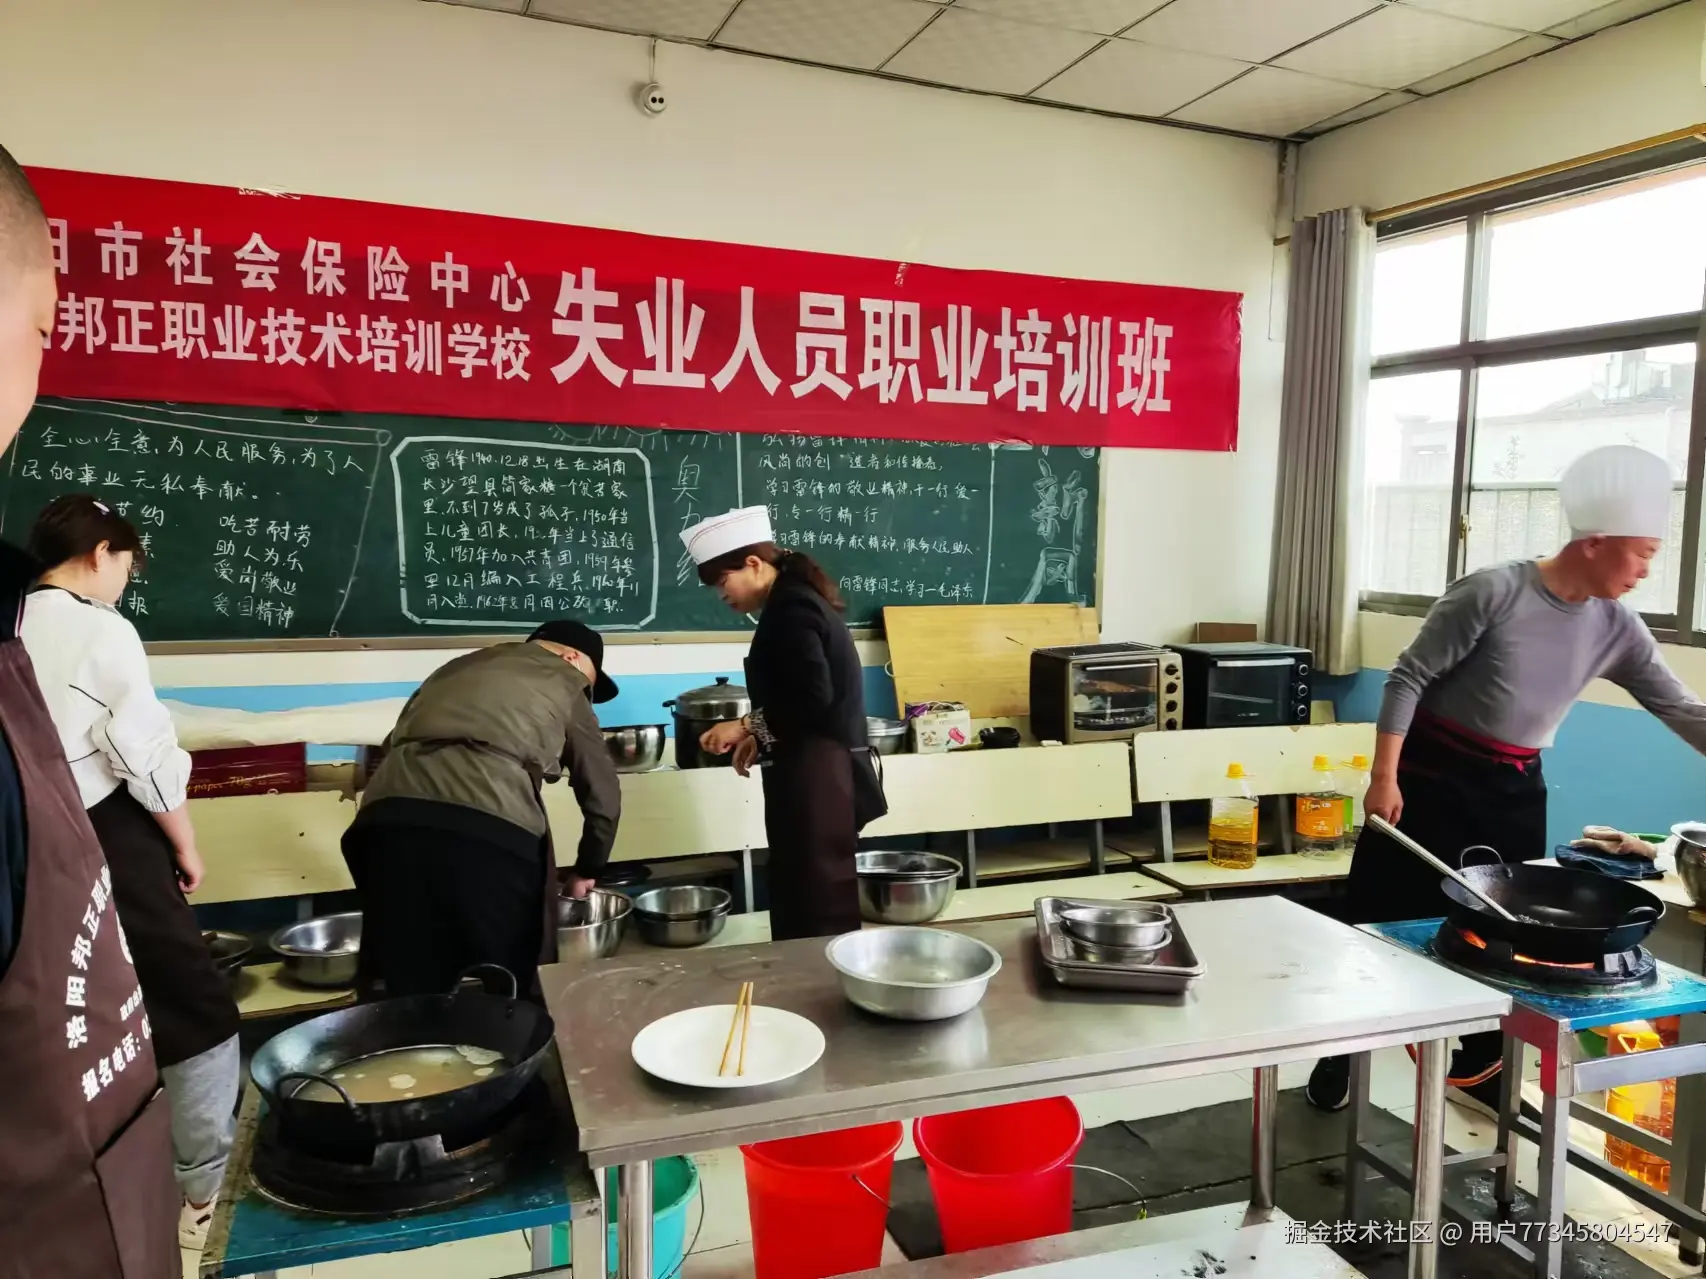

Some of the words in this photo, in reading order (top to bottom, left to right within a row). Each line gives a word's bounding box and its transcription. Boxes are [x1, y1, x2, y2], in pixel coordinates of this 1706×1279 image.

[41, 292, 532, 382] 邦正职业技术培训学校
[551, 267, 1174, 415] 失业人员职业培训班
[218, 513, 312, 548] 吃苦耐劳
[212, 539, 304, 572] 助人为乐
[214, 559, 297, 595] 爱岗敬业
[212, 592, 295, 628] 爱国精神
